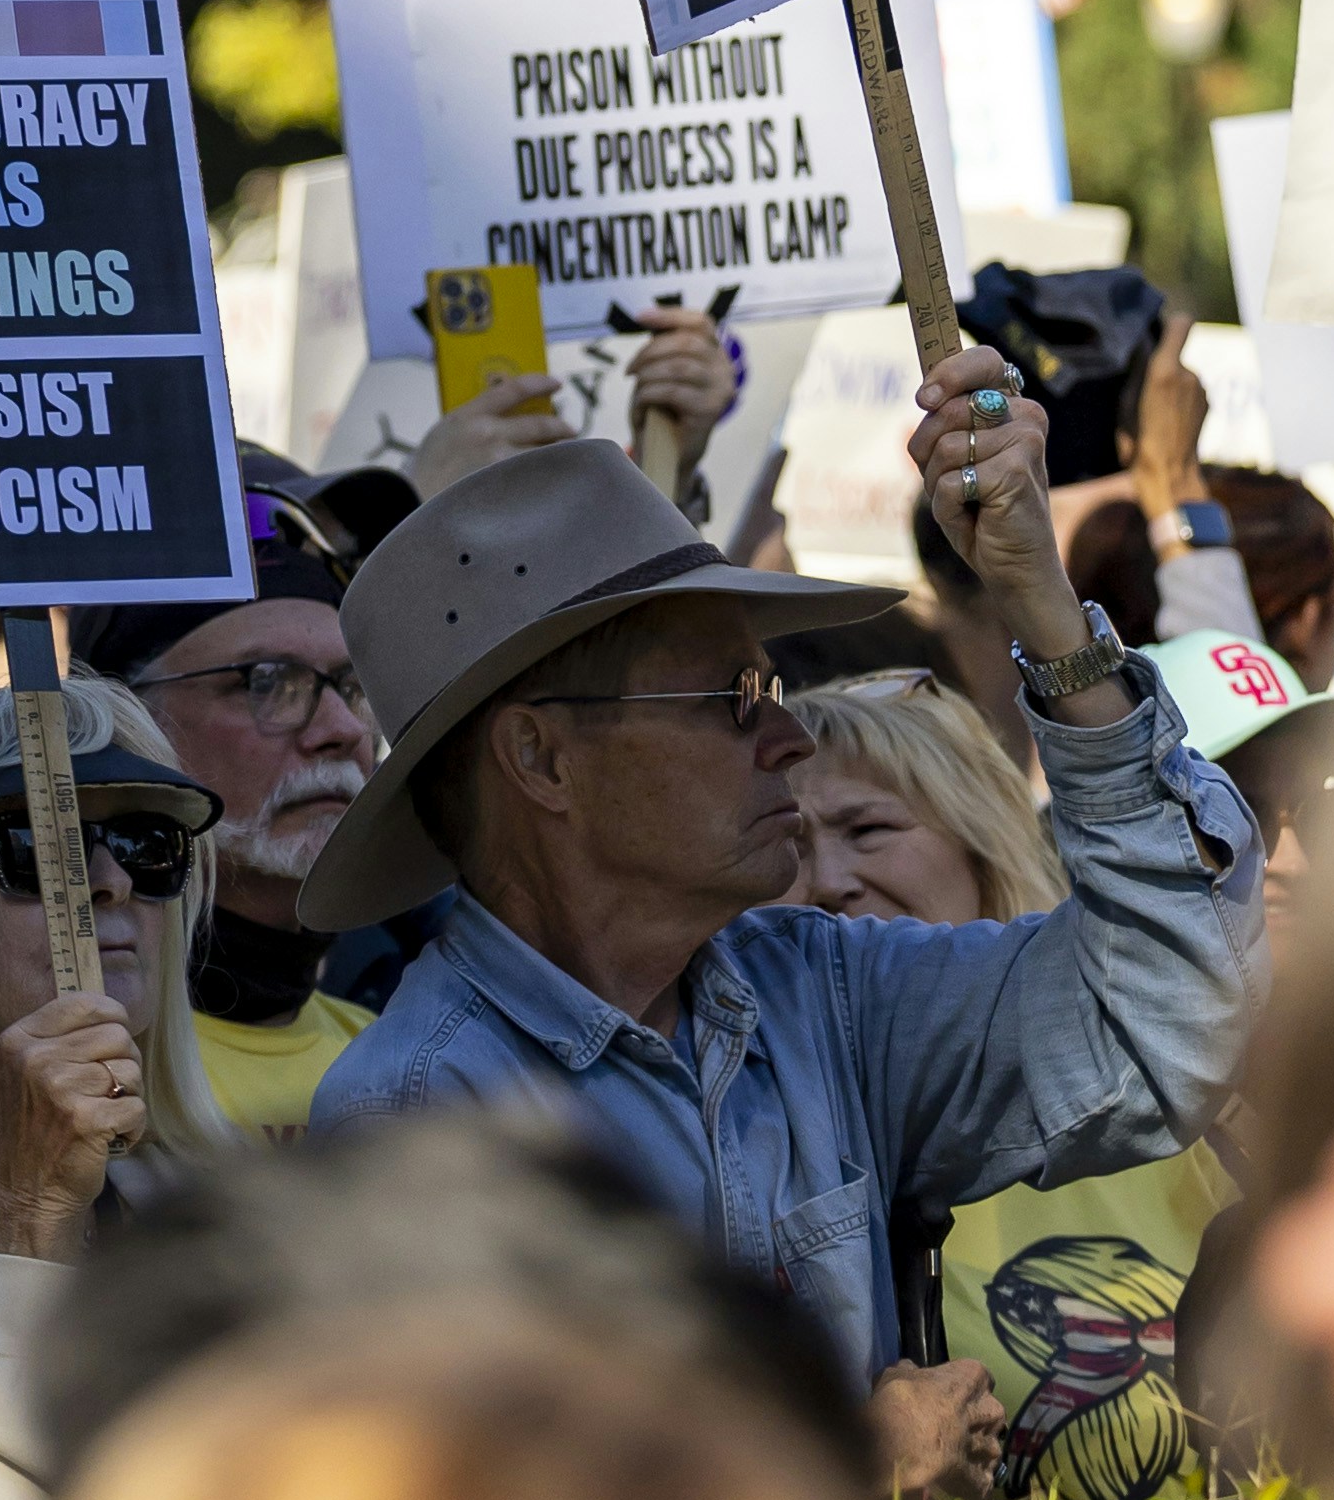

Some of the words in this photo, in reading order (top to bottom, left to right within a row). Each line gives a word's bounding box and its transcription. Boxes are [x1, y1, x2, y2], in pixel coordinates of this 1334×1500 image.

[512, 45, 634, 118] PRISON
[647, 34, 785, 106] WITHOUT
[854, 9, 889, 135] HARDWARE
[515, 133, 583, 201] DUE
[594, 121, 735, 194] PROCESS
[748, 118, 778, 181] IS
[794, 113, 813, 178] A
[487, 204, 750, 284] CONCENTRATION
[765, 194, 850, 264] CAMP
[916, 302, 935, 329] 240
[924, 339, 939, 350] G
[53, 773, 75, 813] 95617
[64, 827, 86, 886] California
[74, 901, 93, 938] Davis,
